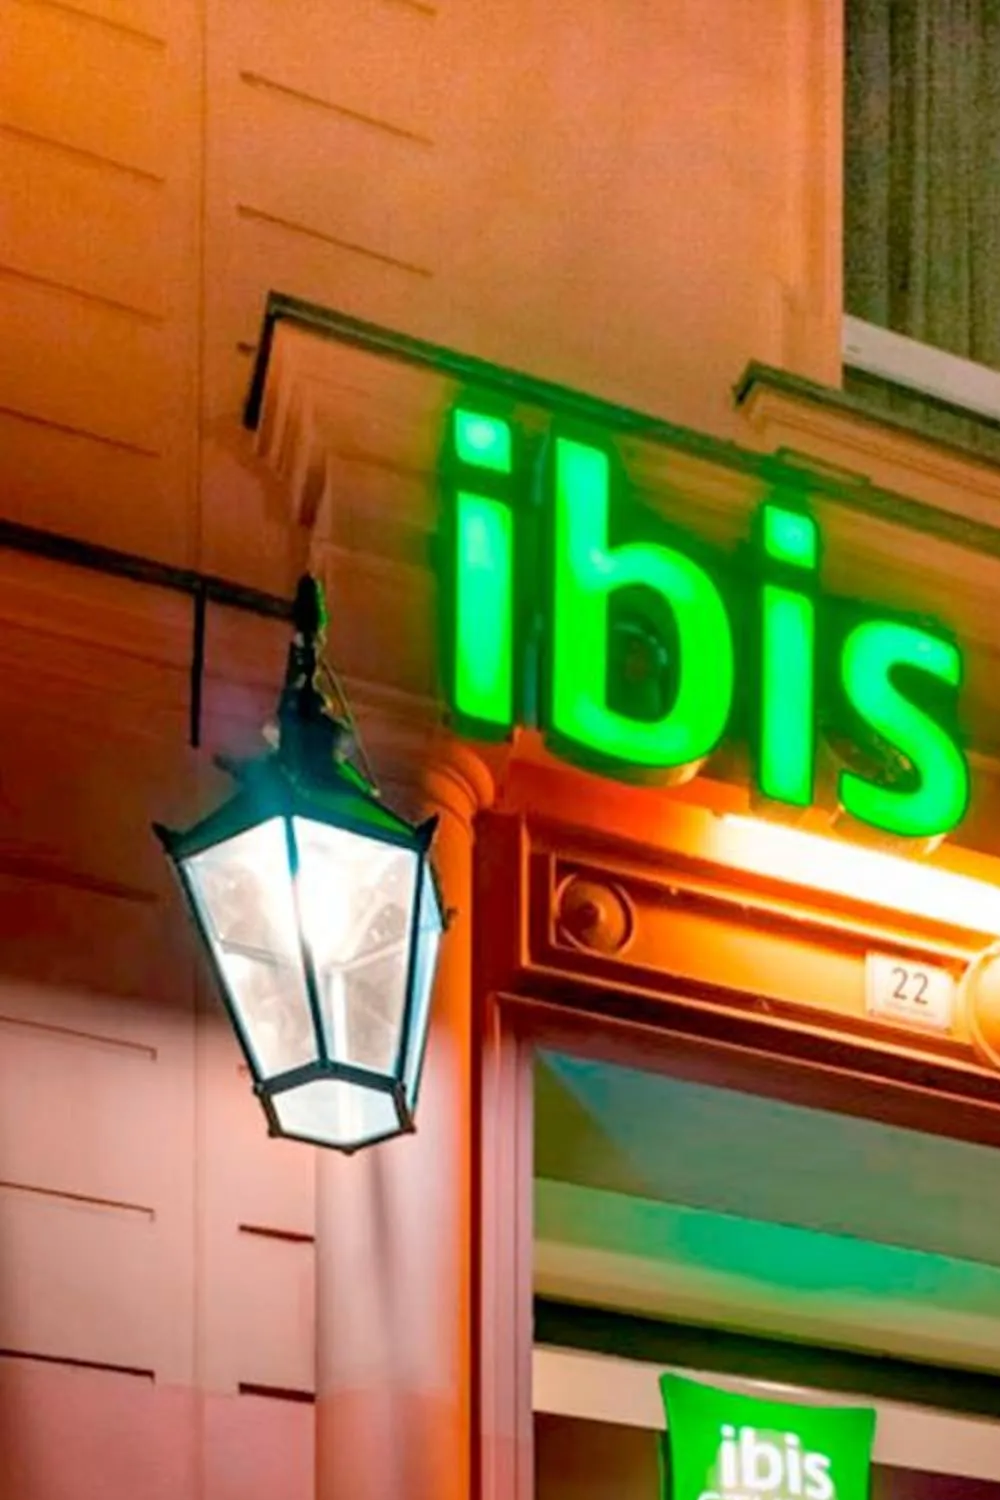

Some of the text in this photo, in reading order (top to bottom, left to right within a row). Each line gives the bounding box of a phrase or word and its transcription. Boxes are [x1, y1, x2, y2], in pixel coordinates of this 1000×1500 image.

[454, 407, 970, 838] ibis
[892, 966, 928, 1005] 22
[720, 1424, 835, 1500] ibis
